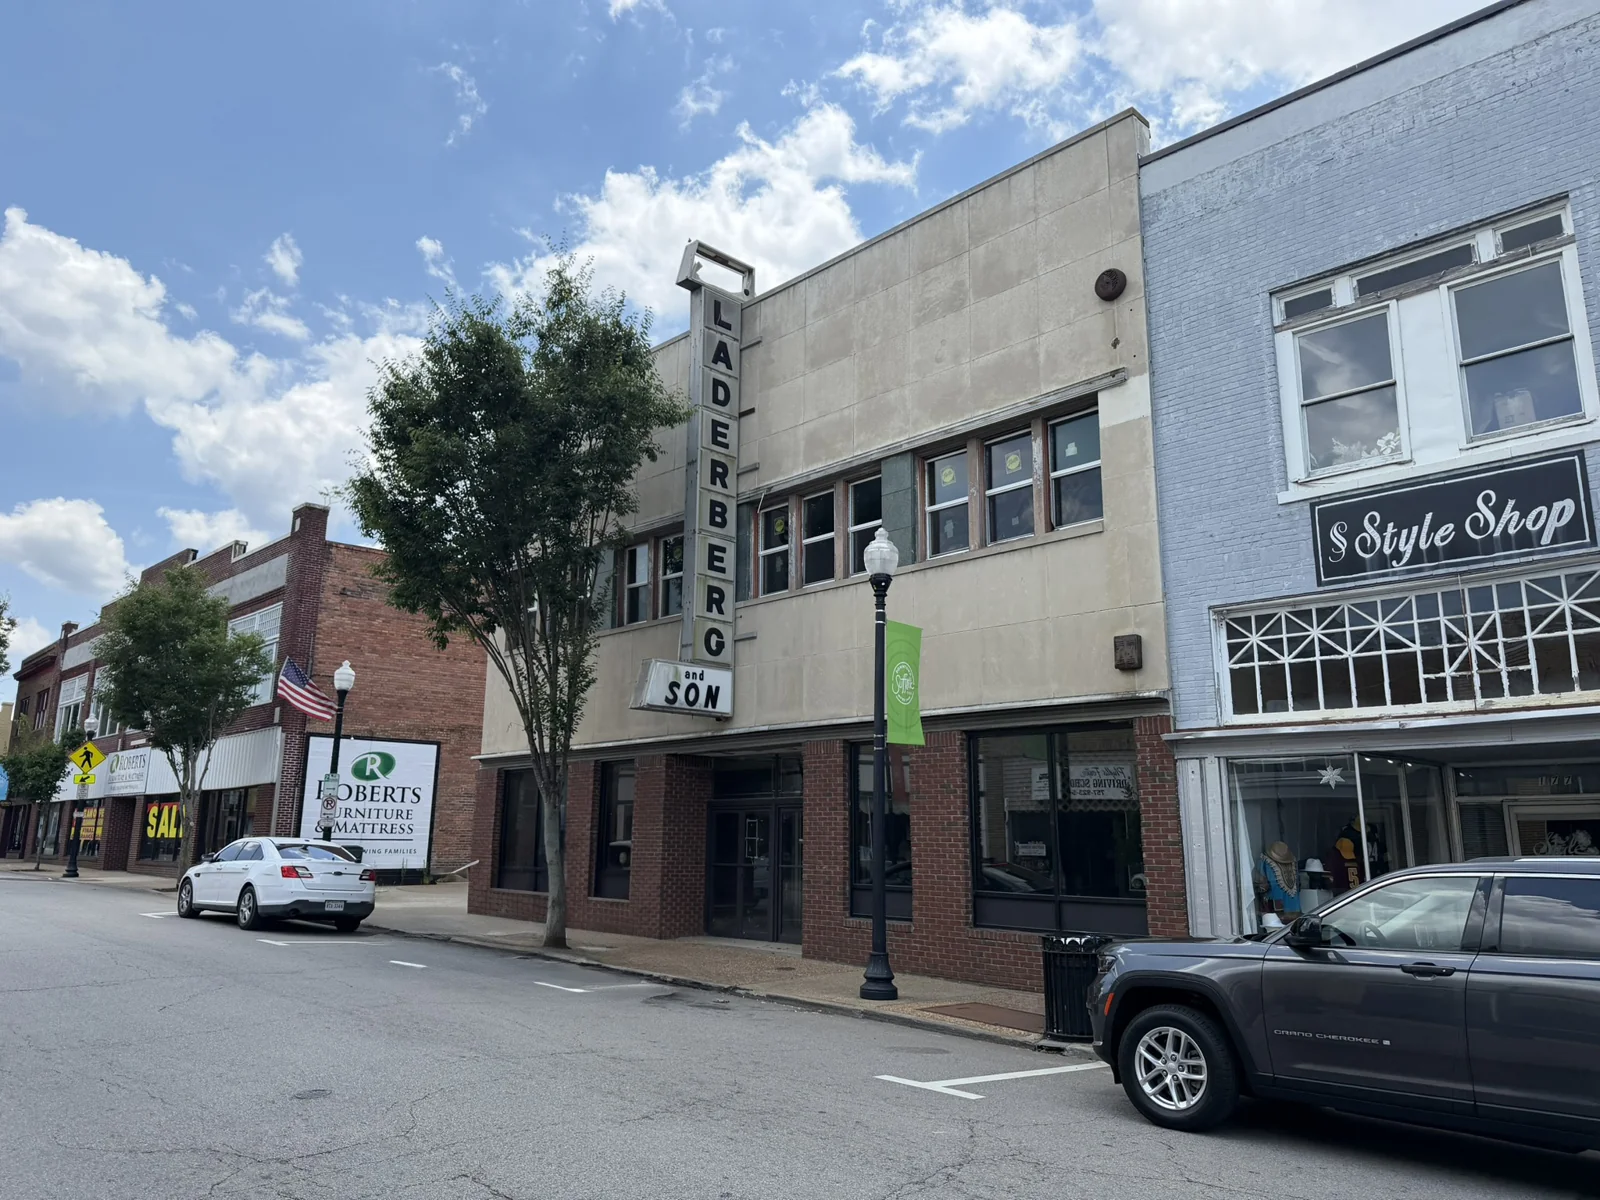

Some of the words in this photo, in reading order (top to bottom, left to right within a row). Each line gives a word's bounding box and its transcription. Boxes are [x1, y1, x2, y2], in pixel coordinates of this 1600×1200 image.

[704, 300, 733, 657] LADERBERG
[1354, 510, 1456, 567] Style
[1464, 489, 1576, 546] Shop
[684, 669, 705, 682] and
[664, 681, 721, 710] SON
[334, 807, 414, 820] URNITURE
[332, 820, 414, 835] MATTRESS
[1273, 1029, 1313, 1038] GRAND
[1315, 1033, 1380, 1045] CHEROKEE
